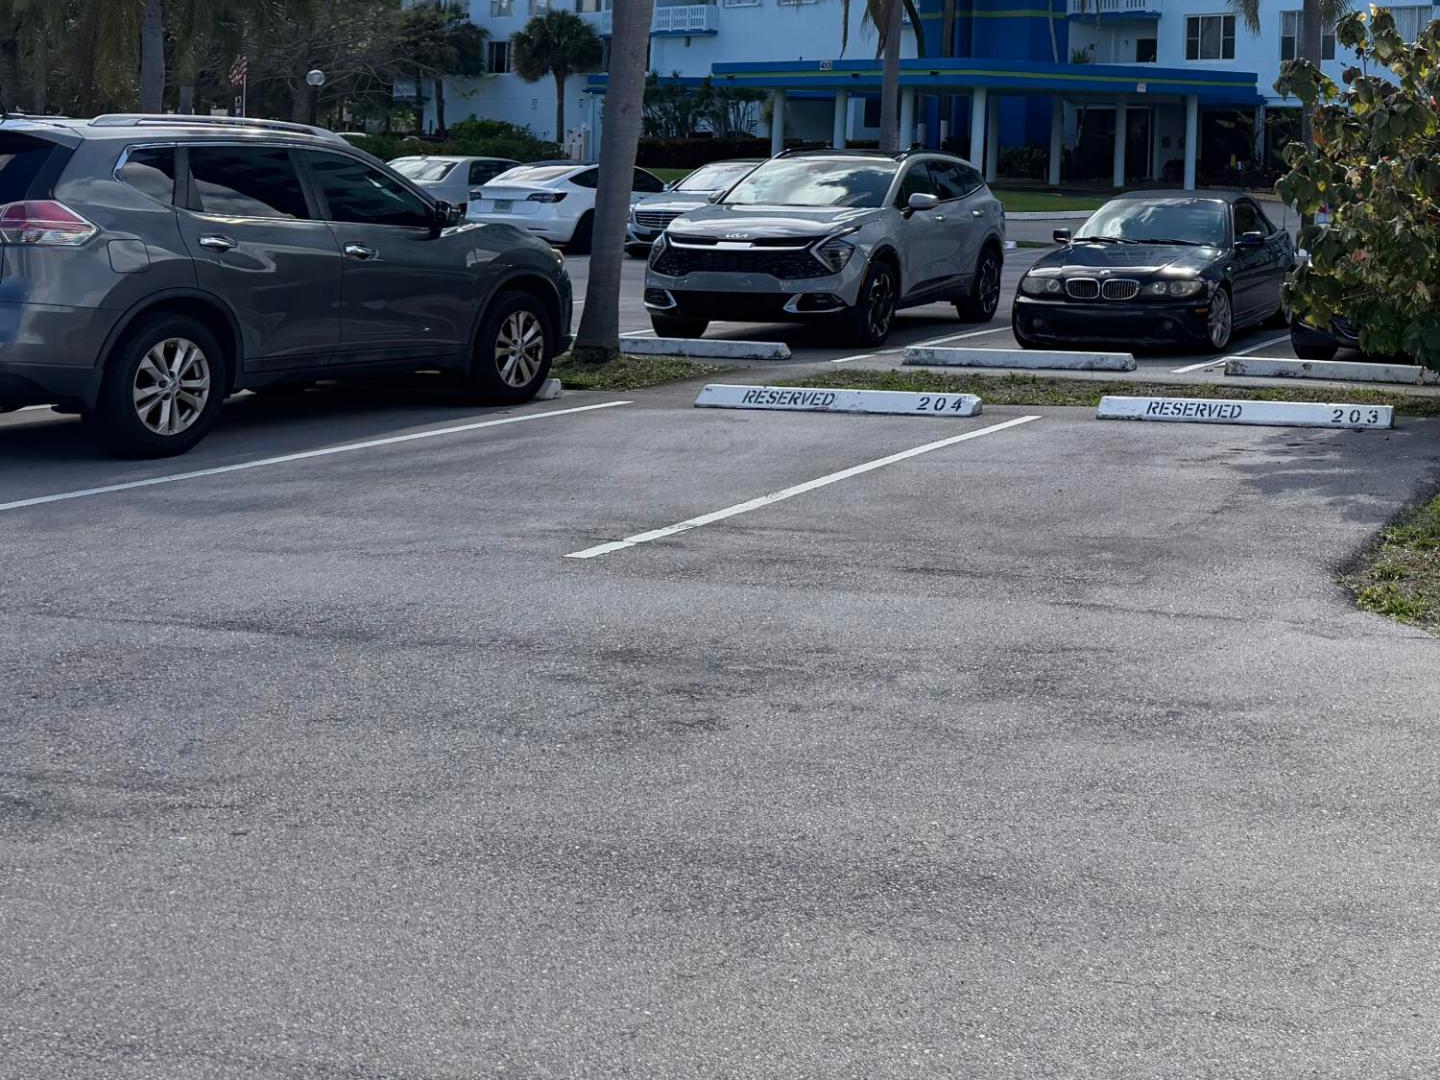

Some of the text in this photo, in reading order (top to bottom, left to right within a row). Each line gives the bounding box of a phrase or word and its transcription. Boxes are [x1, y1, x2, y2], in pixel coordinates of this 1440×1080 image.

[742, 390, 963, 411] RESERVED 204
[1146, 401, 1378, 424] RESERVED 203
